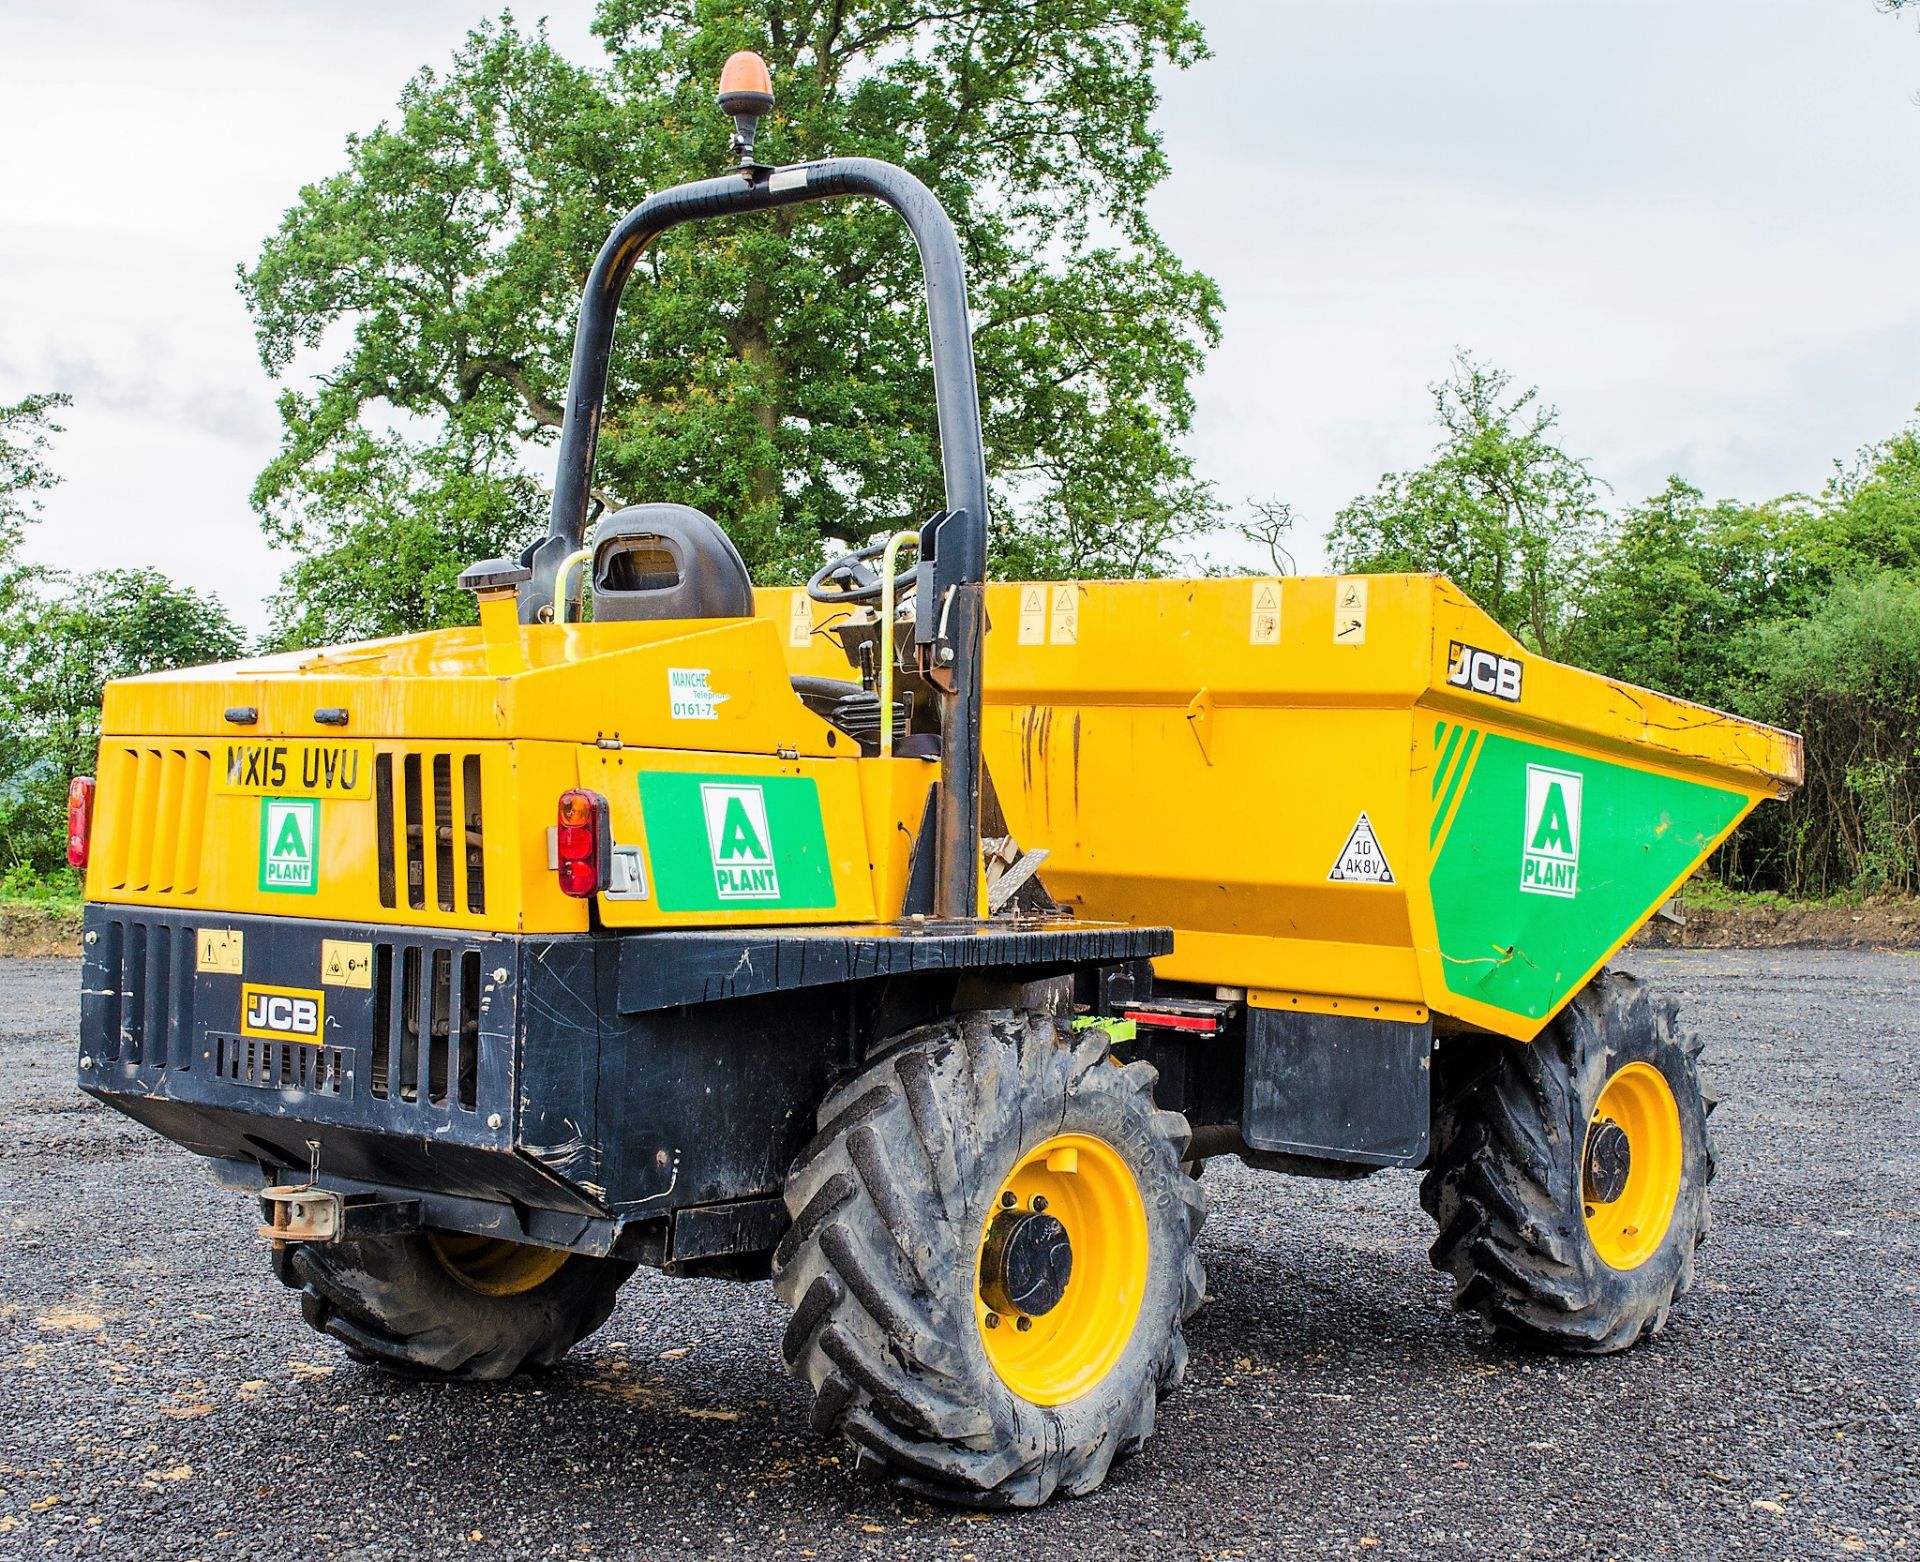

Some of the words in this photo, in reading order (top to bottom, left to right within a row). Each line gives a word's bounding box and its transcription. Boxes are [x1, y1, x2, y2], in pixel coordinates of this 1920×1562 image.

[1448, 648, 1522, 700] JCB
[674, 703, 718, 716] 0161-7
[227, 746, 287, 787] MX15
[302, 748, 358, 790] UVU
[273, 812, 308, 857] A
[719, 797, 768, 859] A
[1531, 782, 1574, 854] A
[268, 863, 310, 881] PLANT
[717, 869, 775, 891] PLANT
[1346, 859, 1380, 874] AK8V
[1523, 858, 1576, 890] PLANT
[248, 996, 318, 1033] JCB
